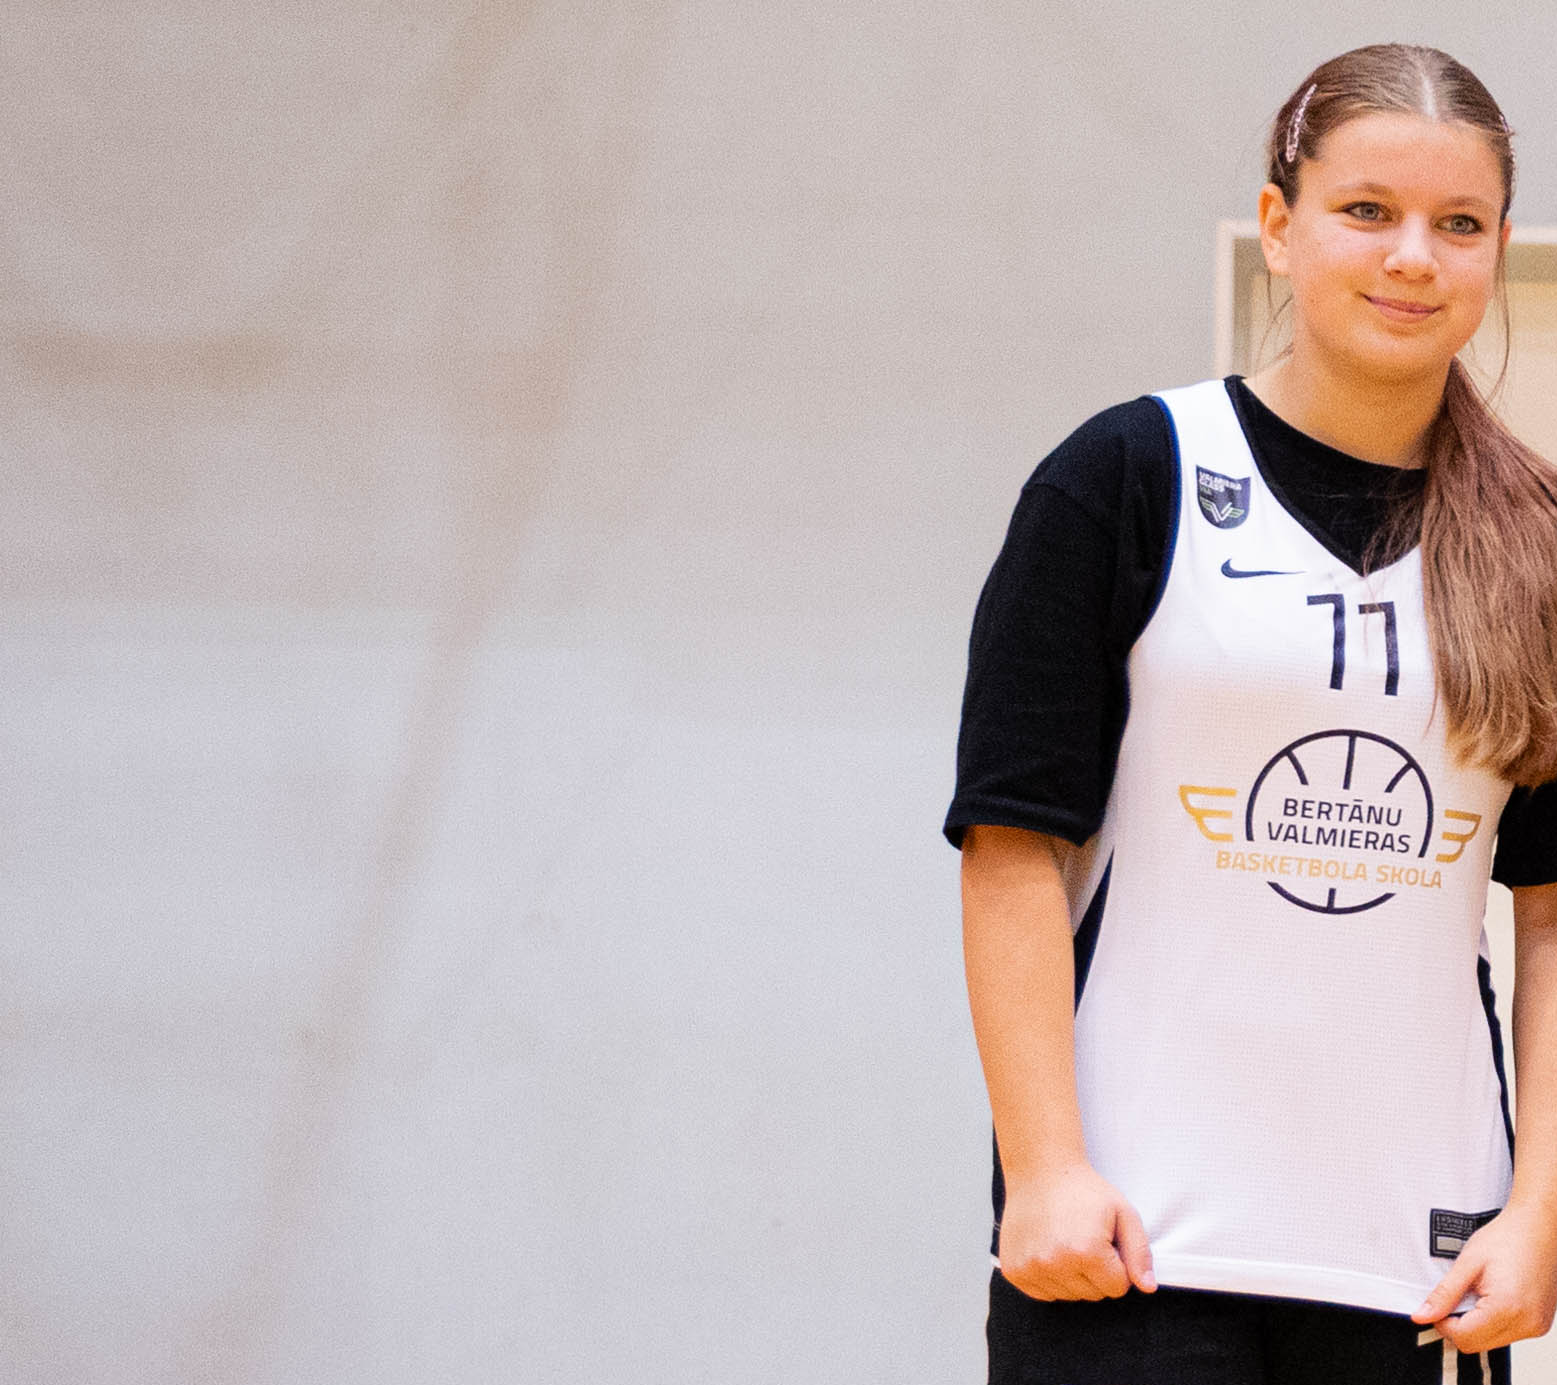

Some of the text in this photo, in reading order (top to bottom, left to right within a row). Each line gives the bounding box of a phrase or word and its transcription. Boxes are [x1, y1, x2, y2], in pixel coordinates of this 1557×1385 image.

[1306, 593, 1400, 697] 11
[1282, 797, 1403, 827] BERTĀNU
[1267, 821, 1412, 854] VALMIERAS
[1216, 849, 1443, 889] BASKETBOLA SKOLA
